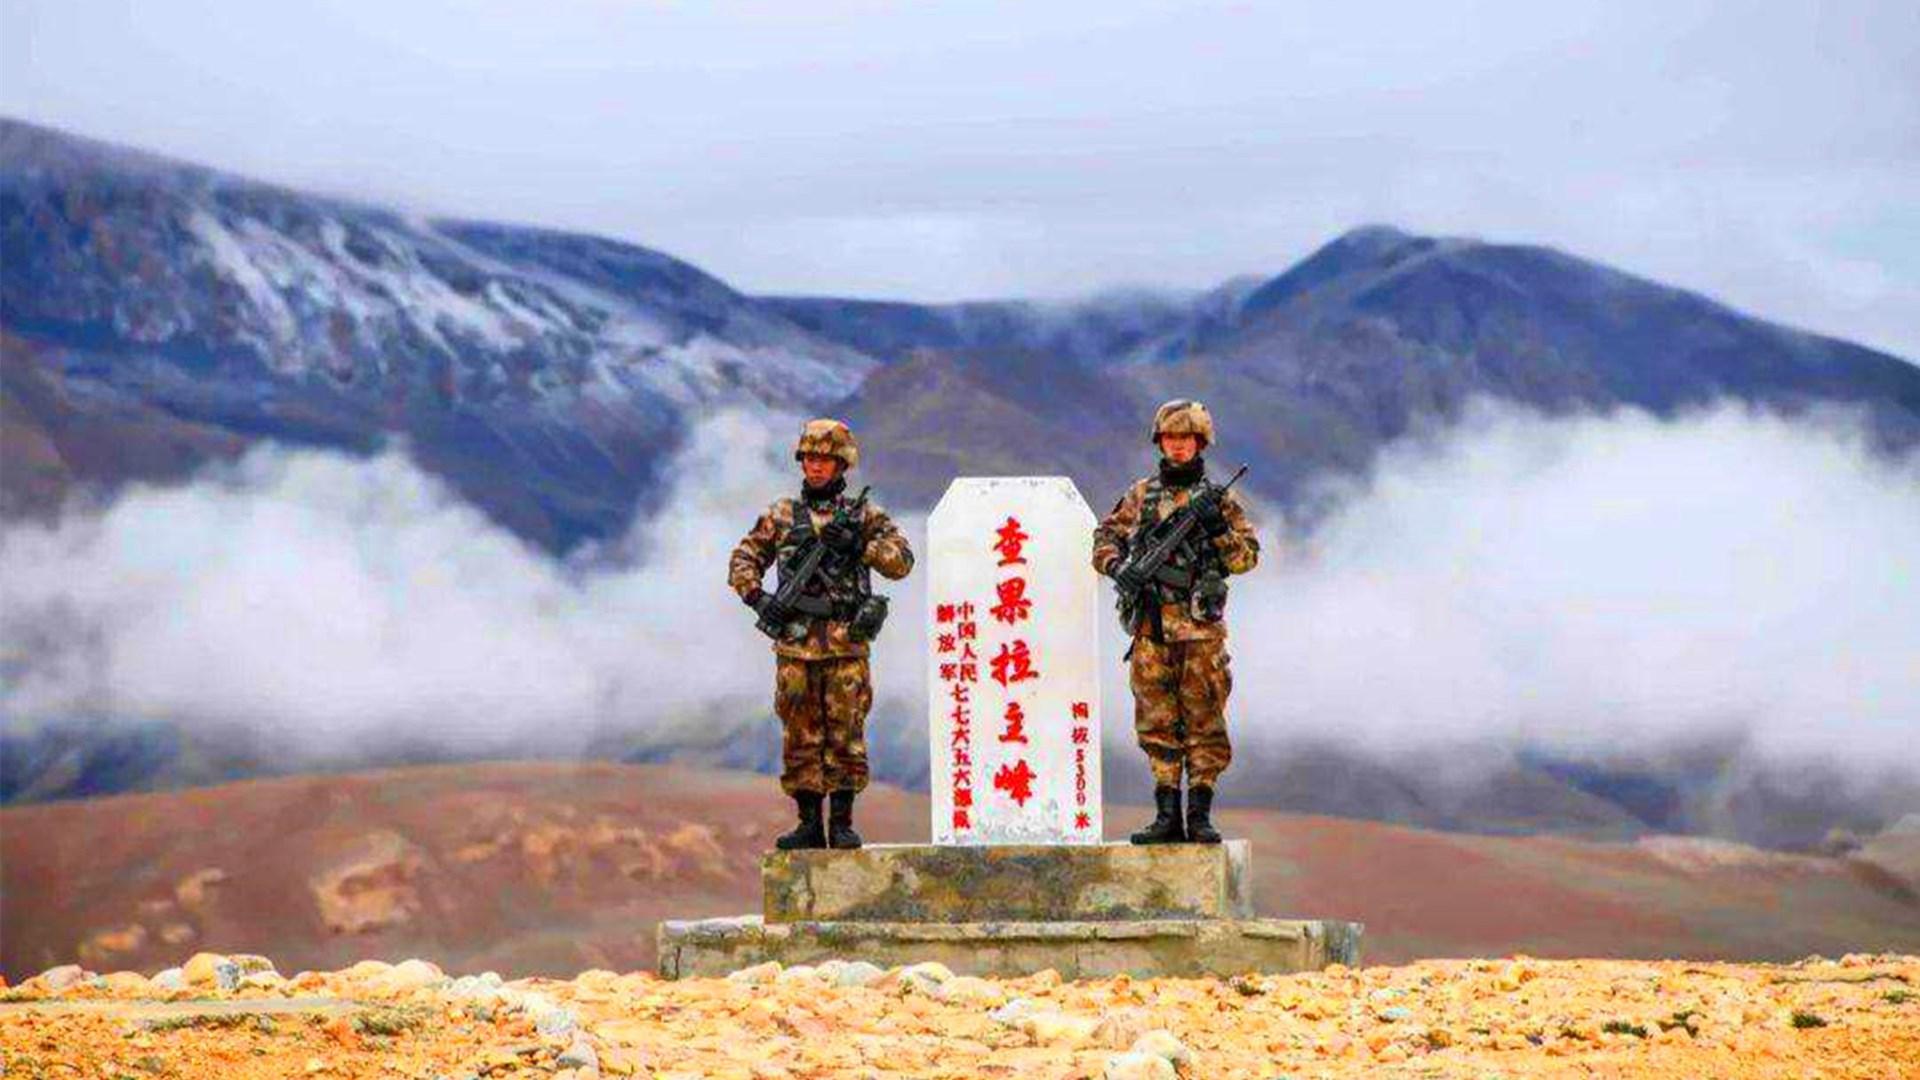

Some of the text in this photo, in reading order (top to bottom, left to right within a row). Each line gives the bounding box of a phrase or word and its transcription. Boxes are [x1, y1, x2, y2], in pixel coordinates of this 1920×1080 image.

[936, 604, 957, 682] 解放军
[958, 602, 978, 683] 中国人民
[988, 516, 1038, 808] 查果拉主峰
